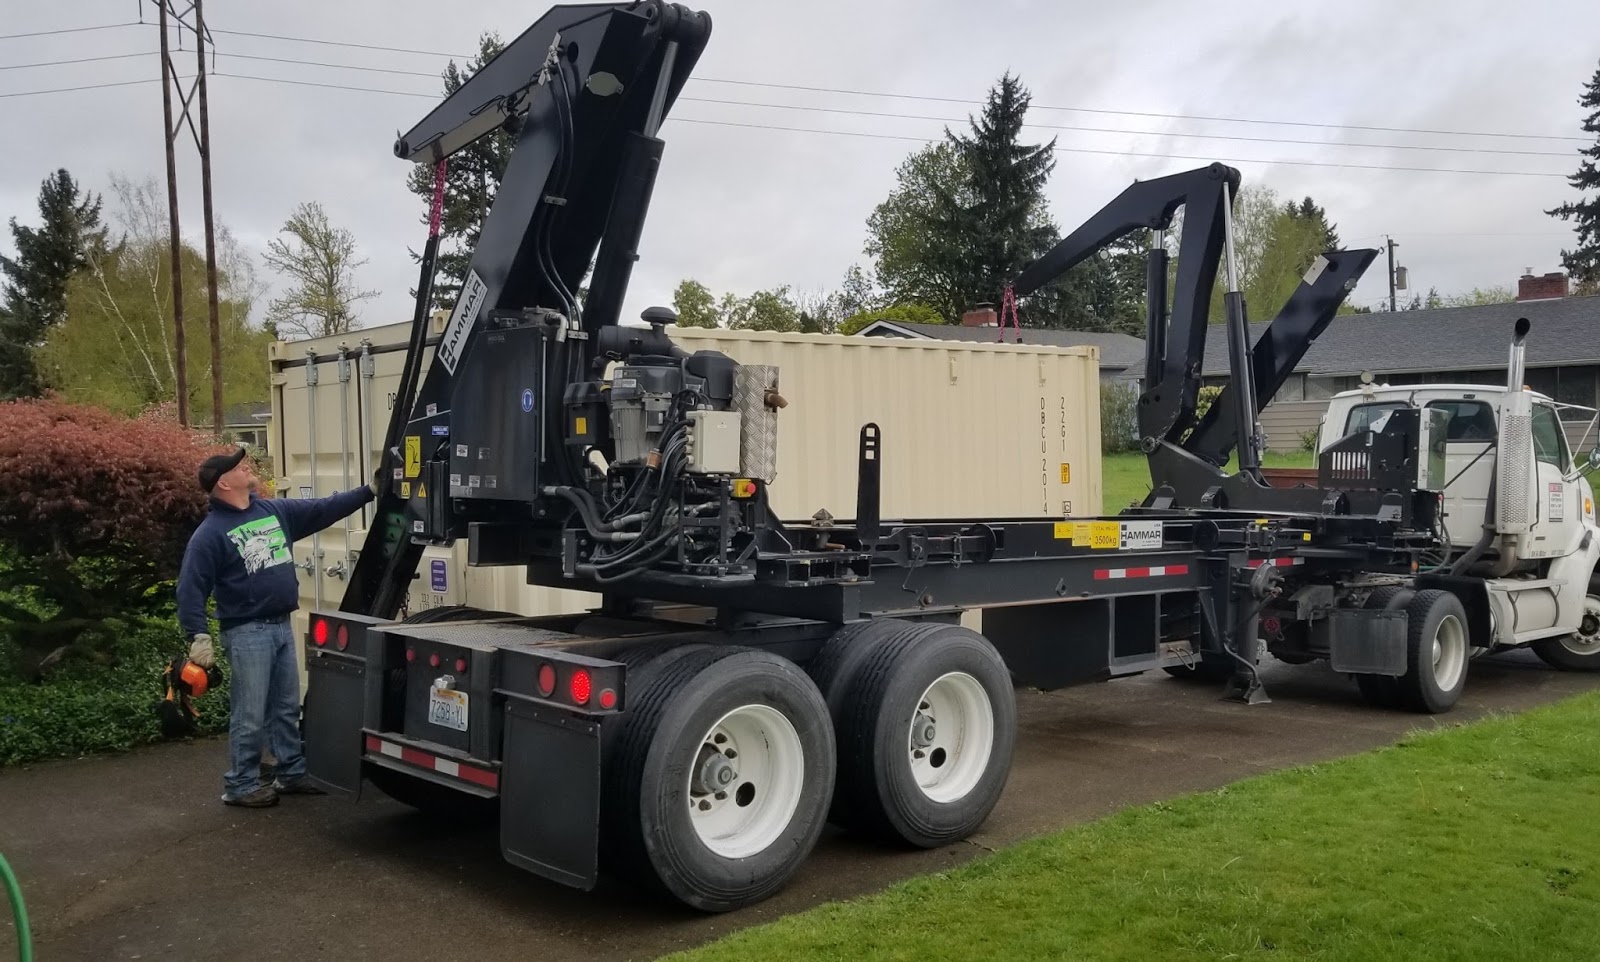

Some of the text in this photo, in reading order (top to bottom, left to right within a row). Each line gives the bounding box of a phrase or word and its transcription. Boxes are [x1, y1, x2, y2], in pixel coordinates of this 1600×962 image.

[443, 279, 482, 367] HAMMAR
[1095, 535, 1117, 547] 3500kg
[1121, 531, 1161, 540] HAMMAR
